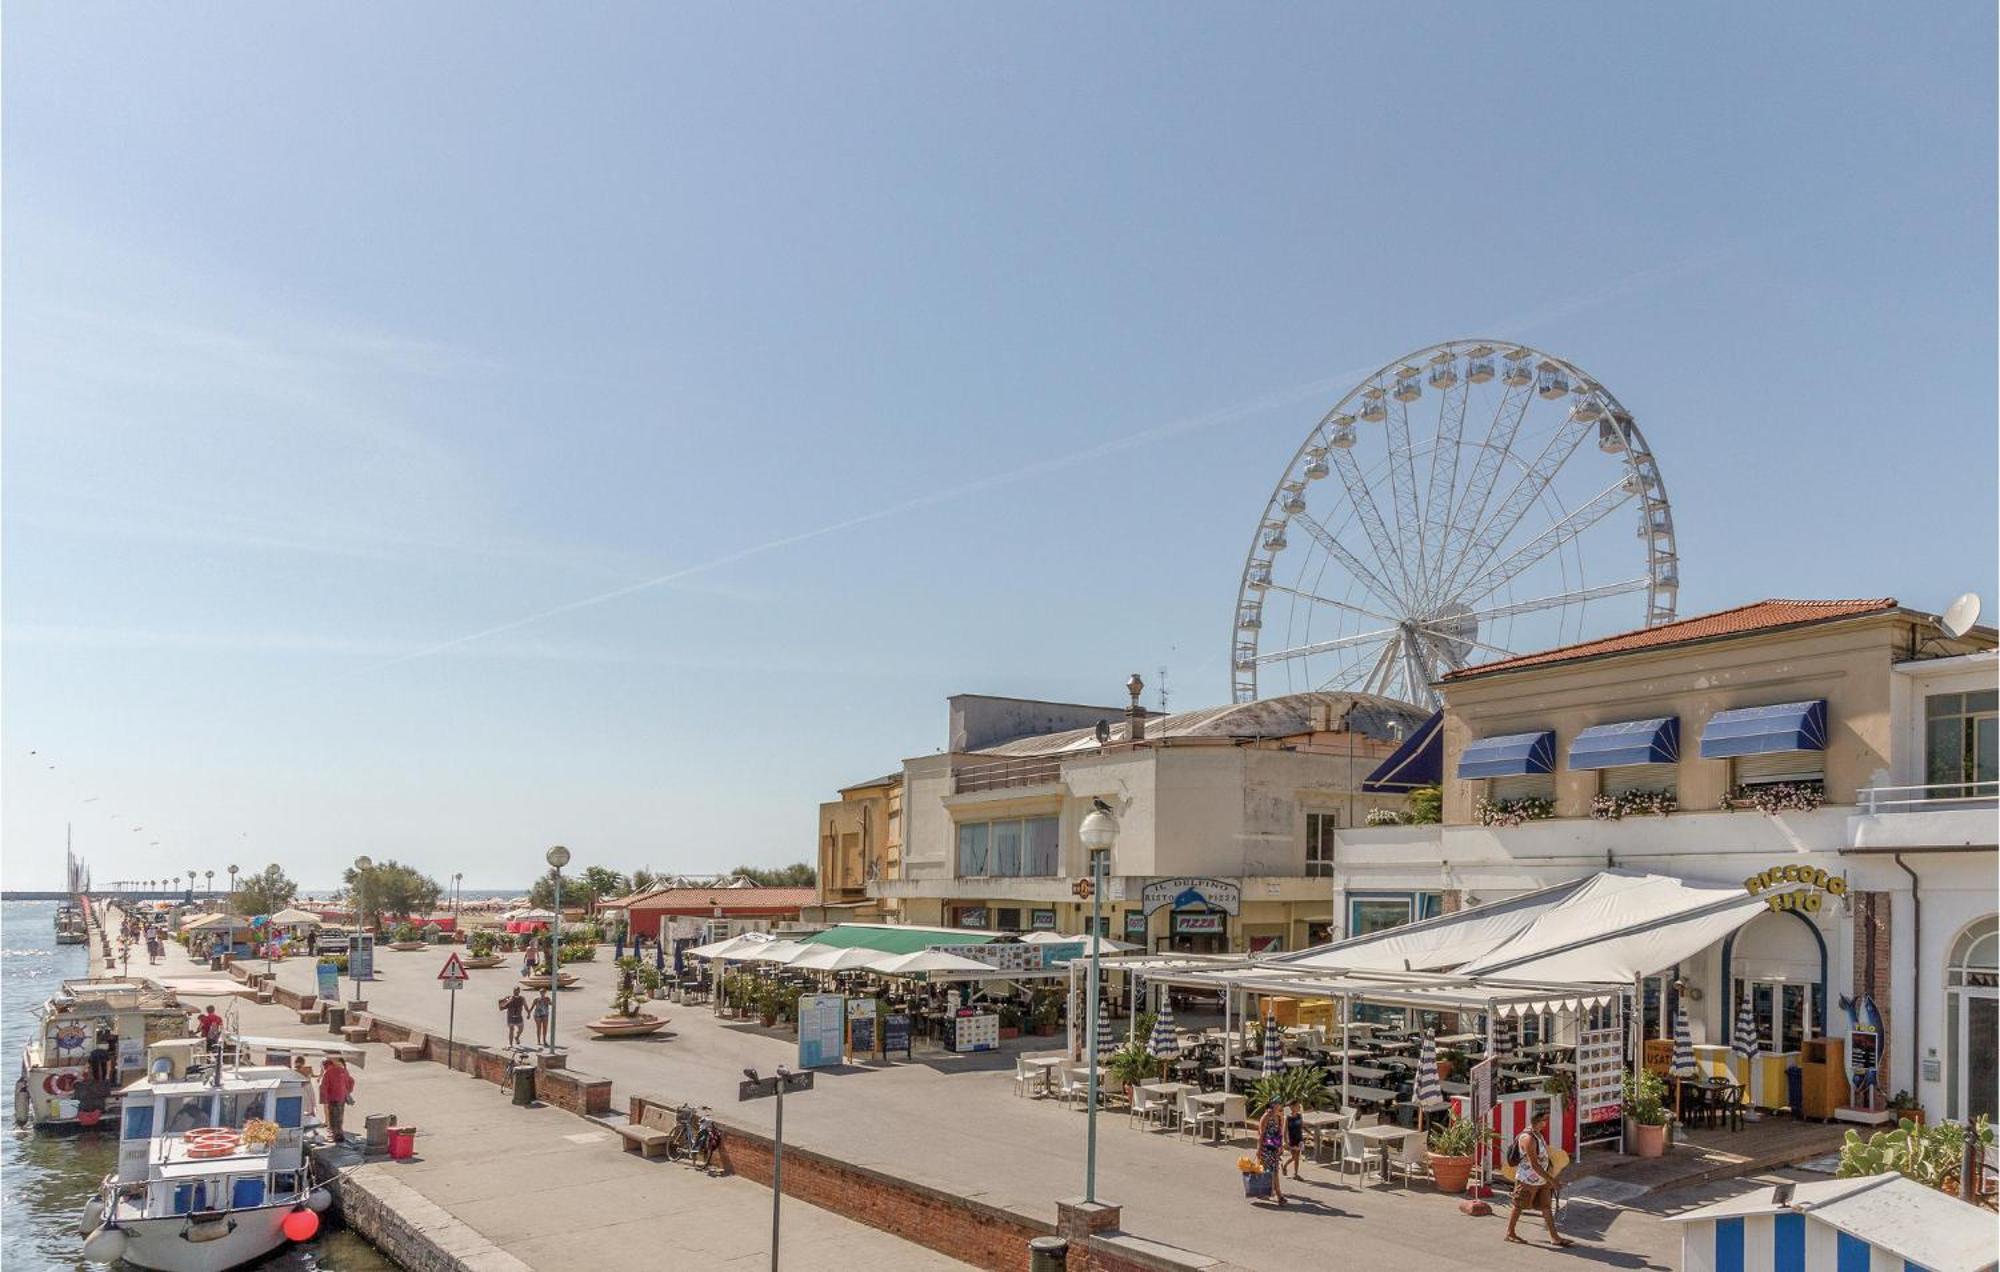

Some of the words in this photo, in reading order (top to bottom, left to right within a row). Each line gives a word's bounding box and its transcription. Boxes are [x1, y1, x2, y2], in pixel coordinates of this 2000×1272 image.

[1174, 879, 1229, 891] DELFINO
[1744, 864, 1847, 897] PICCOLO
[1144, 894, 1175, 902] RISTO
[1207, 893, 1238, 902] PIZZA
[1767, 889, 1823, 914] TITO
[1178, 917, 1217, 929] PIZZA
